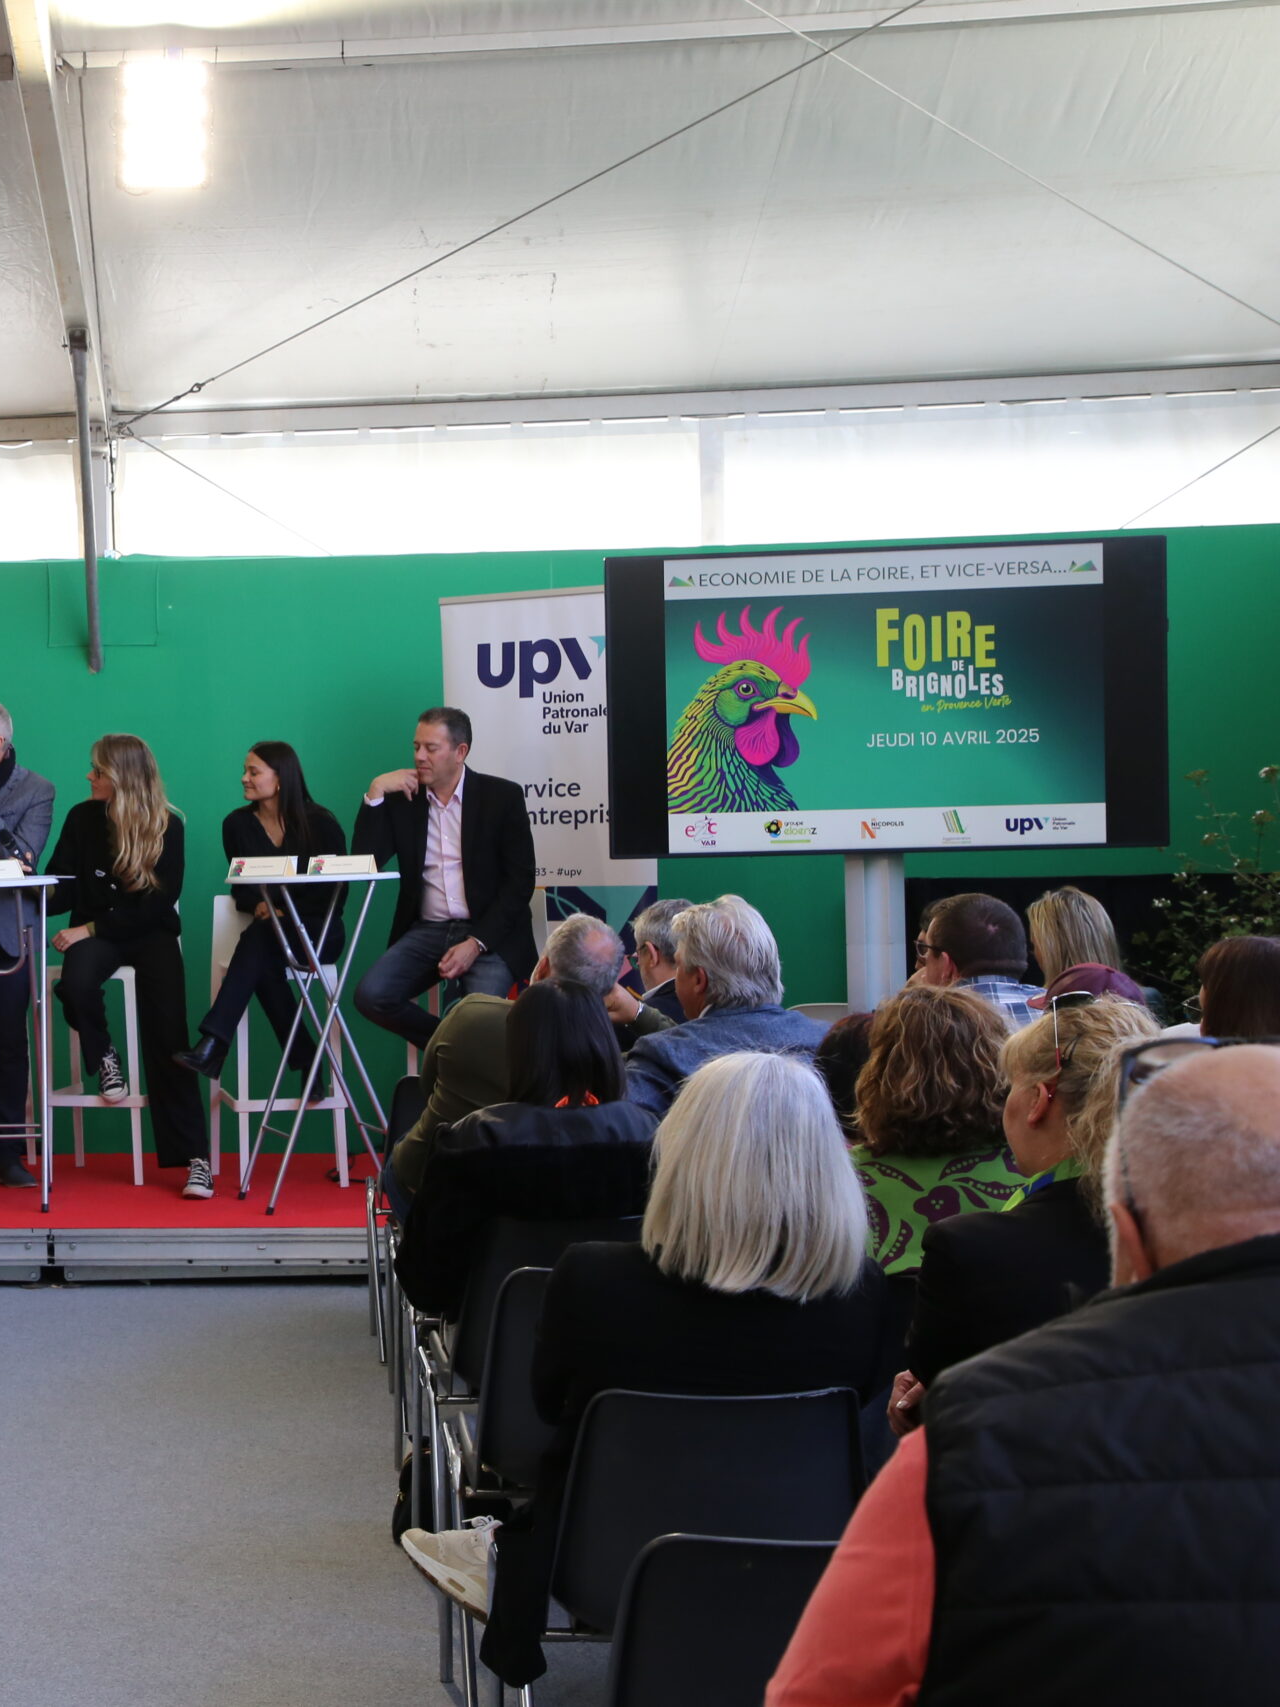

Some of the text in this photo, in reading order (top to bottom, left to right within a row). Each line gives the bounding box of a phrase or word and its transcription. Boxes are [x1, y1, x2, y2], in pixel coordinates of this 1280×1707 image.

[699, 560, 1068, 587] ECONOMIE DE LA FOIRE, ET VICE-VERSA...
[876, 608, 997, 672] FOIRE
[951, 660, 965, 671] DE
[891, 665, 1004, 702] BRIGNOLES
[542, 690, 584, 704] Union
[921, 695, 1012, 714] en Provence Verte
[542, 720, 589, 735] du Var
[867, 728, 1040, 748] JEUDI 10 AVRIL 2025
[524, 777, 581, 798] rvice
[1005, 817, 1050, 835] upv
[557, 867, 582, 878] #upv
